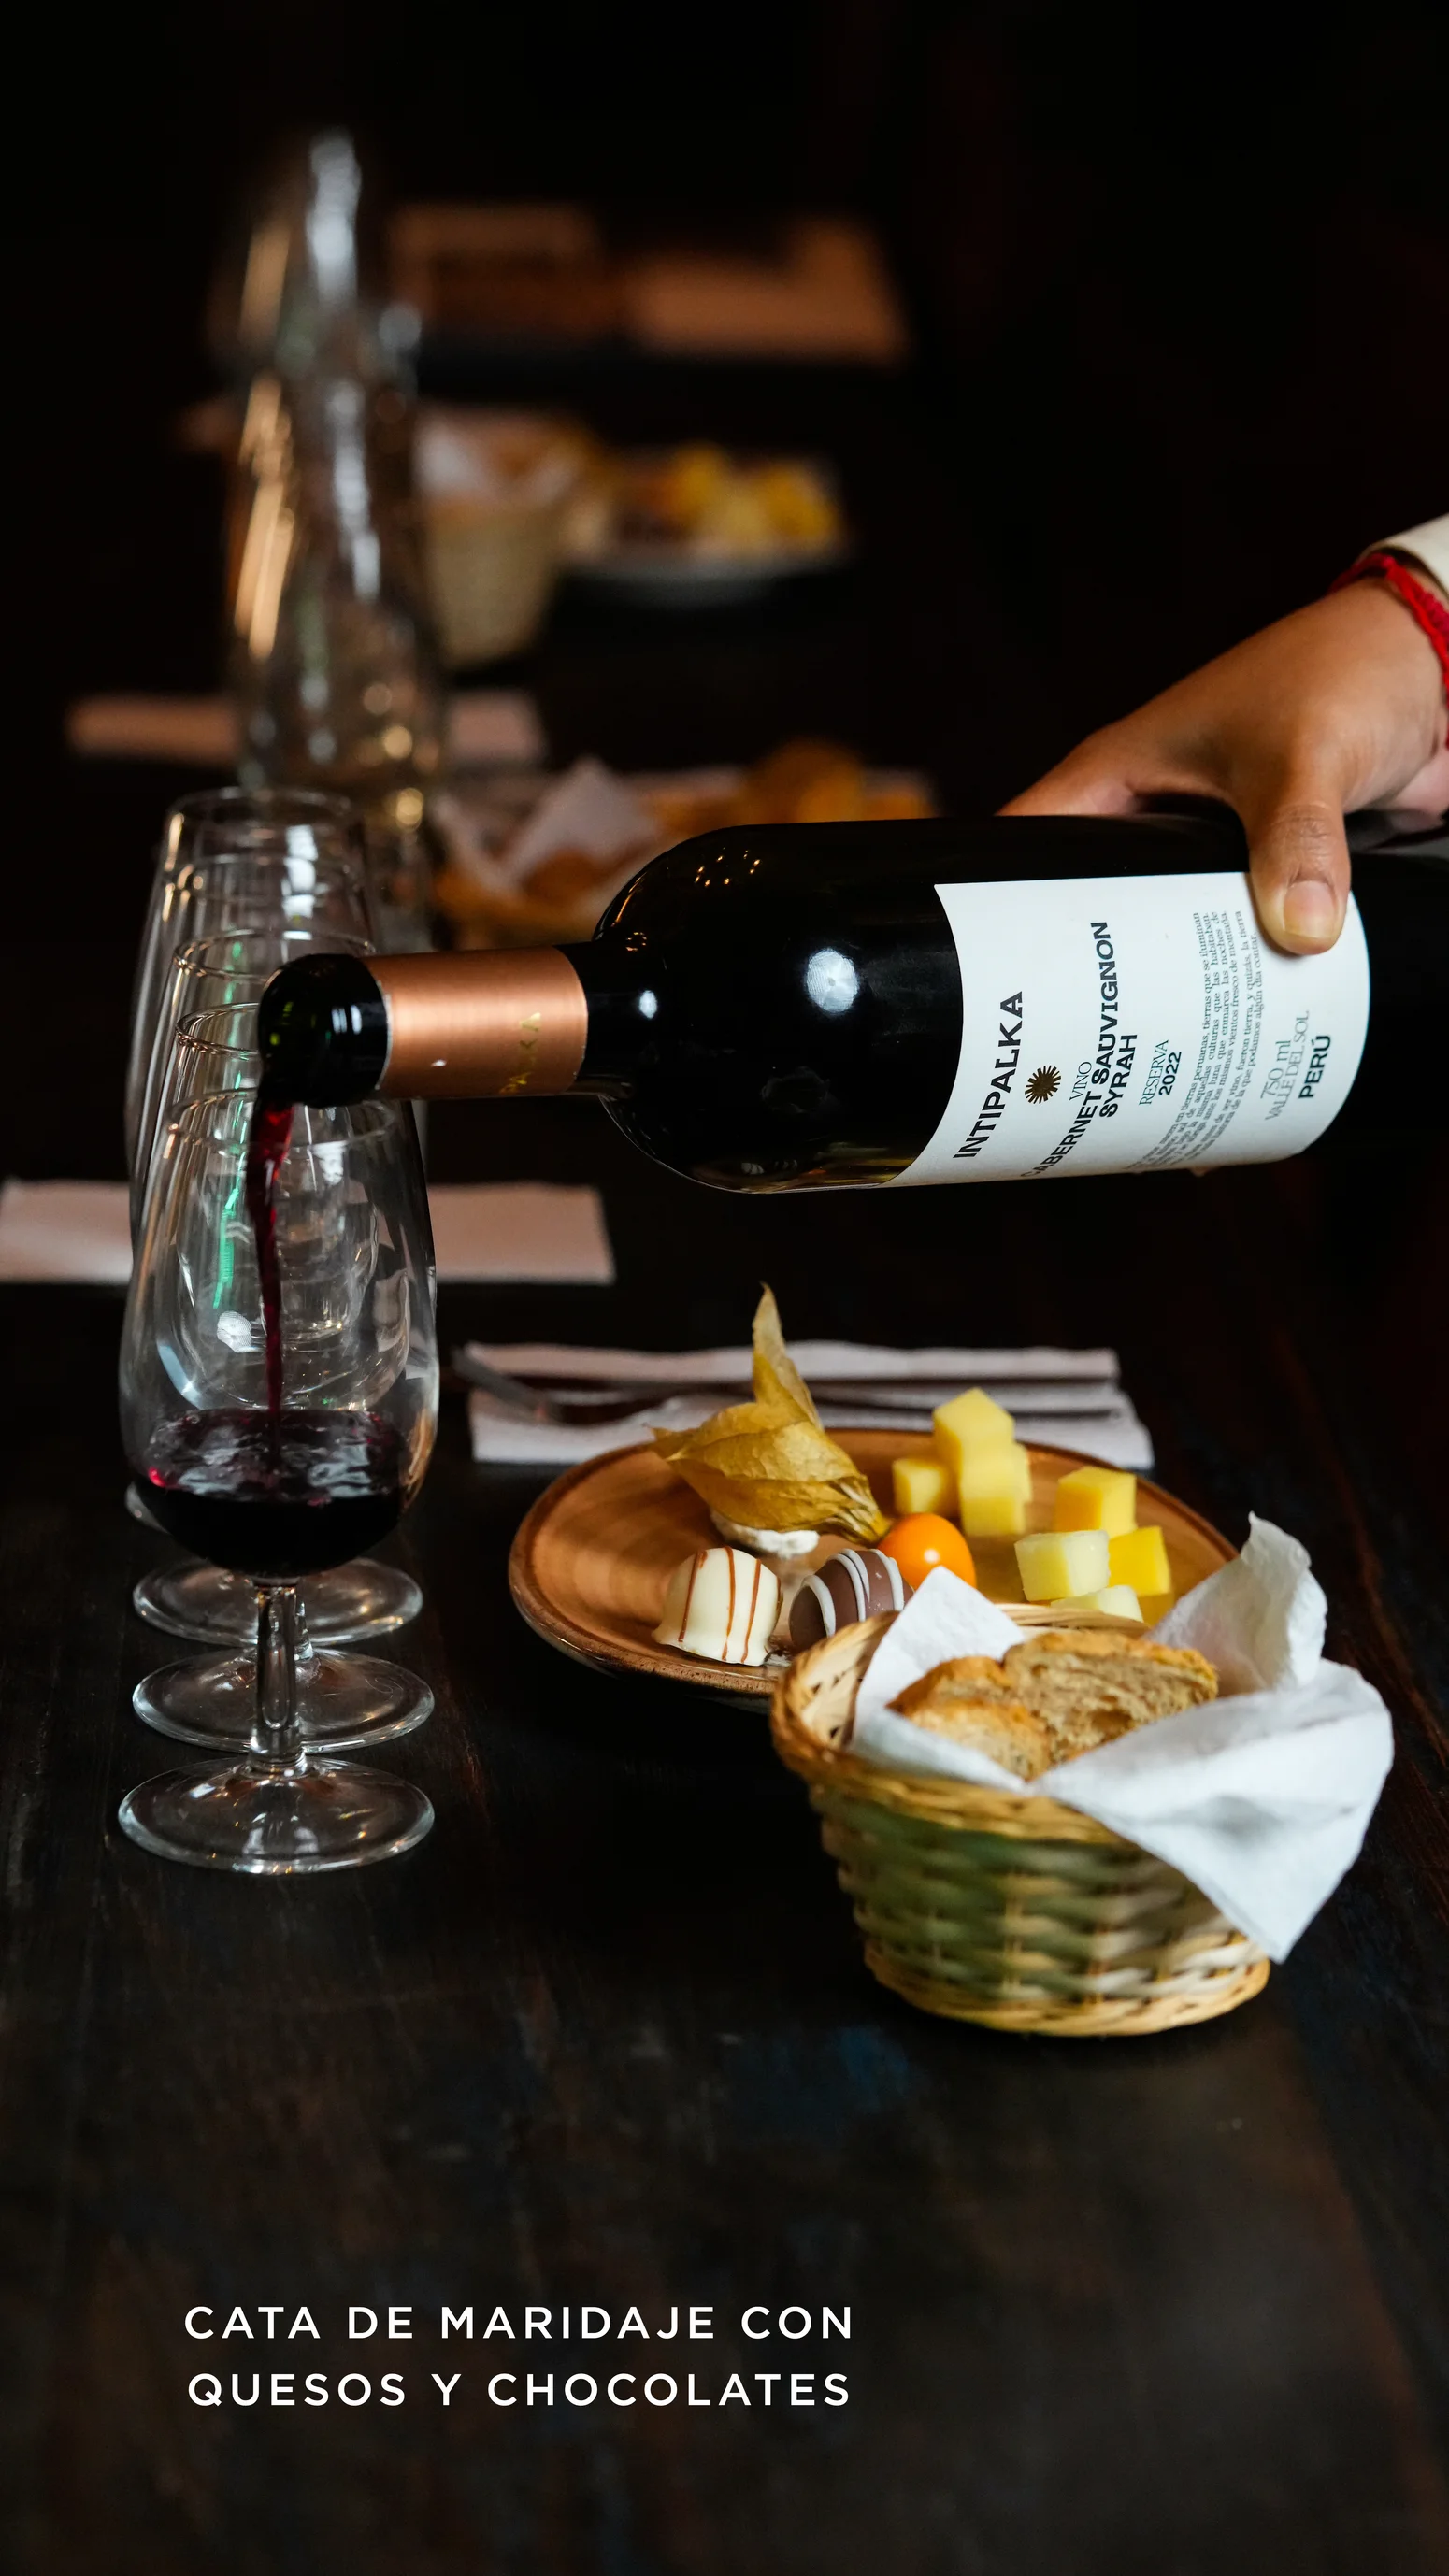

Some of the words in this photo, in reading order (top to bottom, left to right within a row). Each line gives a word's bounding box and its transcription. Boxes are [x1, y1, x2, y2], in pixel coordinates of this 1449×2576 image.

[1193, 912, 1208, 956] iluminan
[1211, 912, 1219, 923] de
[1235, 911, 1247, 937] tierra
[1203, 960, 1209, 970] se
[1216, 929, 1227, 964] noches
[1203, 974, 1212, 993] que
[1202, 996, 1211, 1029] tierras
[1212, 1087, 1223, 1100] los
[1219, 1049, 1234, 1085] mismos
[1229, 960, 1237, 972] de
[1293, 1011, 1309, 1042] SOL
[1021, 1091, 1102, 1177] CABERNET
[1091, 922, 1119, 1085] SAUVIGNON
[1193, 1034, 1210, 1079] peruanas,
[1195, 1066, 1211, 1102] aquellas
[1209, 1020, 1219, 1060] culturas
[1235, 1038, 1250, 1070] fueron
[1236, 1089, 1245, 1097] la
[1241, 1068, 1253, 1086] que
[1248, 1021, 1261, 1066] podamos
[1255, 991, 1264, 1018] algún
[1285, 1045, 1305, 1076] DEL
[953, 991, 1023, 1159] INTIPALKA
[1069, 1061, 1092, 1101] VINO
[1099, 1035, 1137, 1118] SYRAH
[1139, 1039, 1169, 1106] RESERVA
[1158, 1052, 1182, 1096] 2022
[1208, 1064, 1221, 1085] luna
[1260, 1069, 1283, 1098] 750
[1275, 1040, 1291, 1062] ml
[1298, 1036, 1331, 1098] PERÚ
[1181, 1082, 1198, 1110] tierras
[1196, 1091, 1212, 1117] misma
[1265, 1080, 1295, 1120] VALLE
[1175, 1111, 1184, 1123] en
